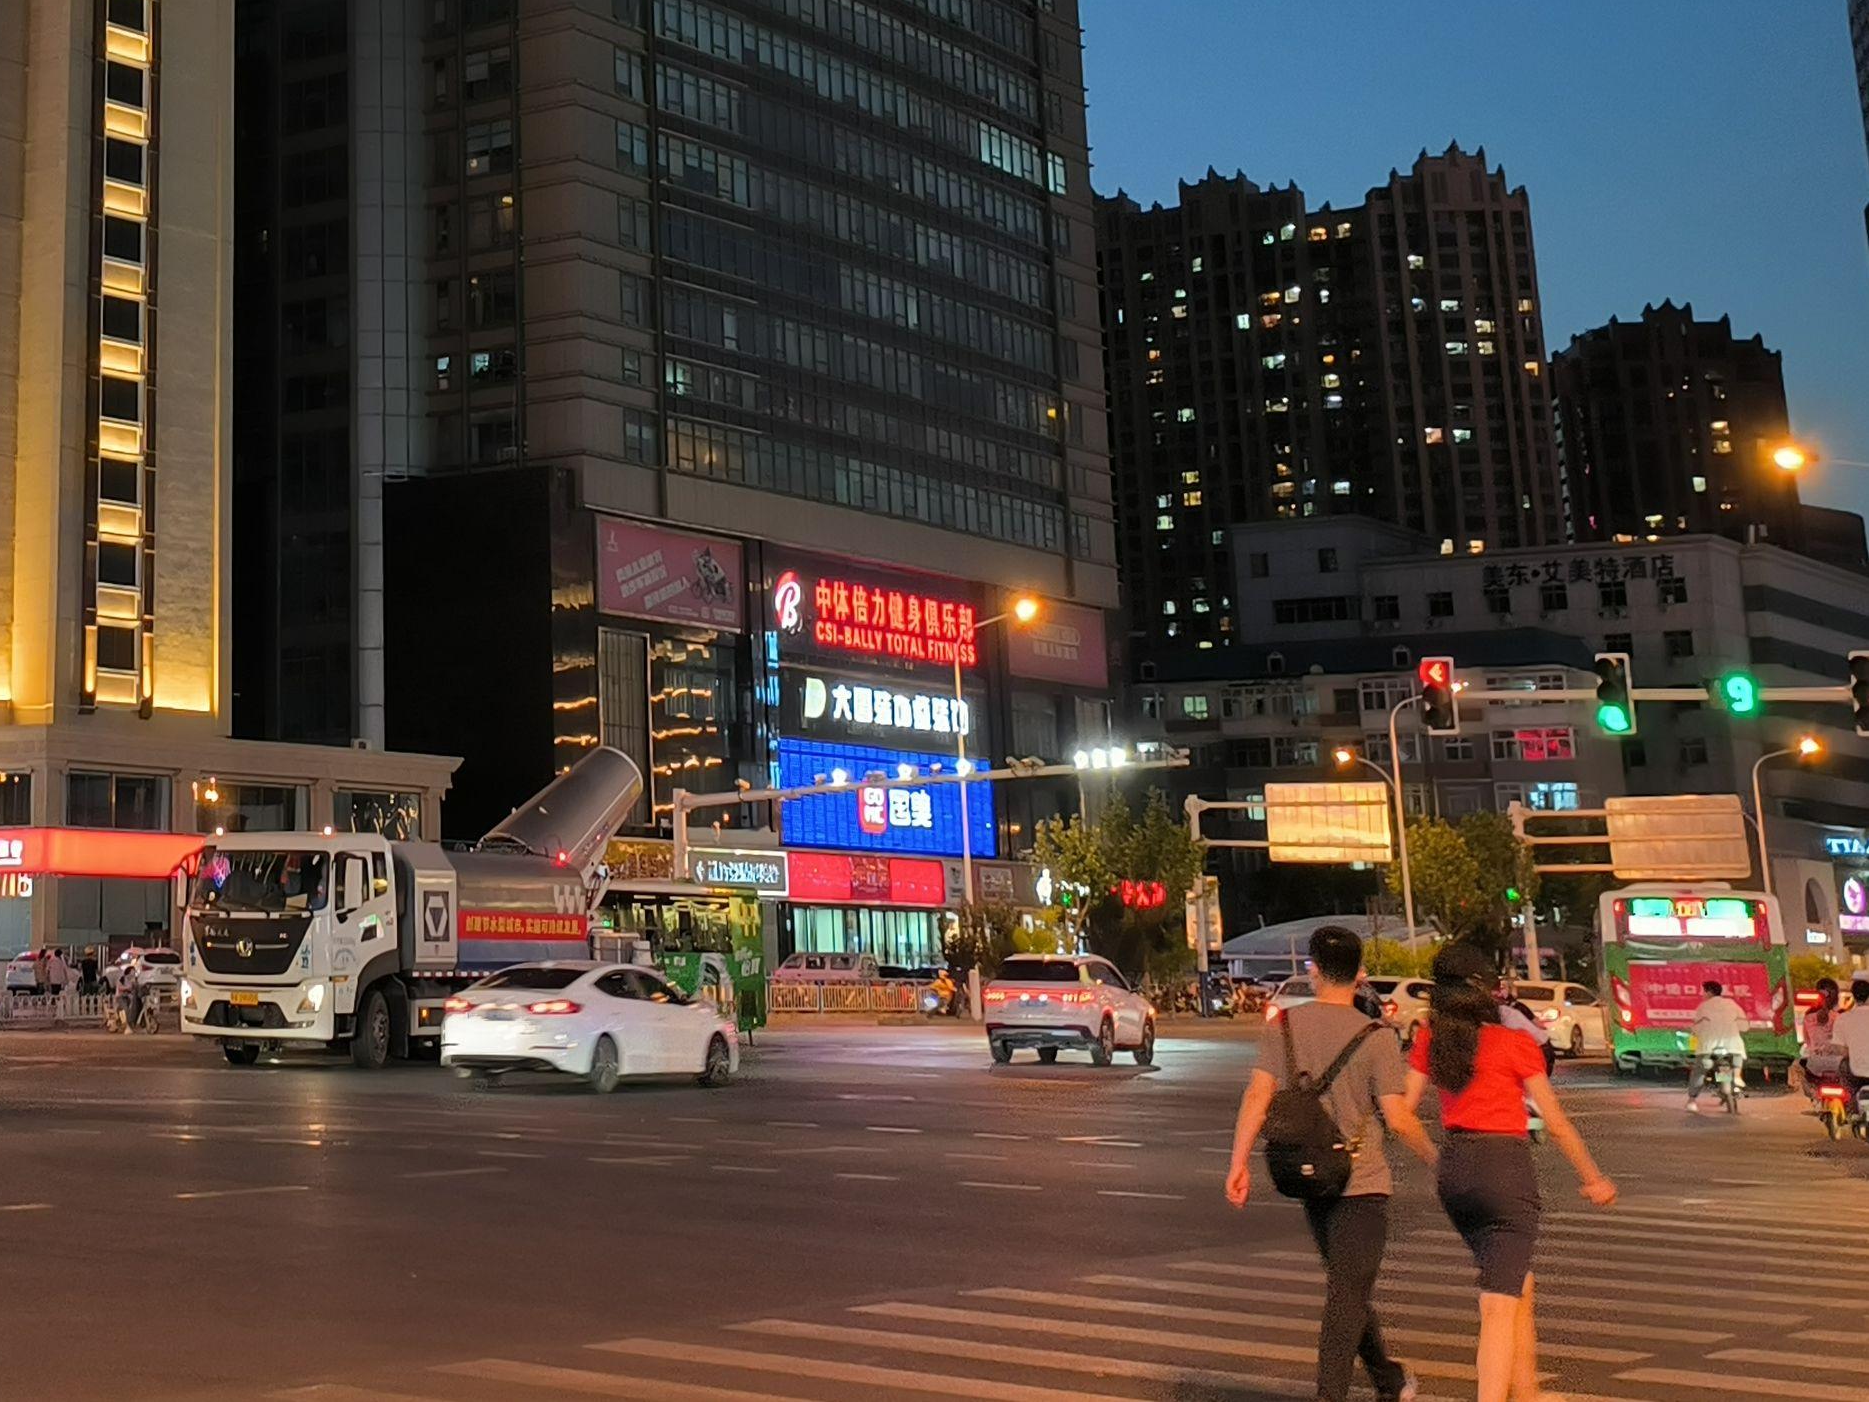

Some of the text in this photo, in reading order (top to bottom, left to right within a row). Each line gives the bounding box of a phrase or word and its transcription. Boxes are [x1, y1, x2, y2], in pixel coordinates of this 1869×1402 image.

[815, 578, 974, 642] 中体倍力健身俱乐部
[816, 621, 976, 663] CSI-BALLY TOTAL FITNSS
[1727, 677, 1755, 712] 9
[888, 788, 933, 828] 国美
